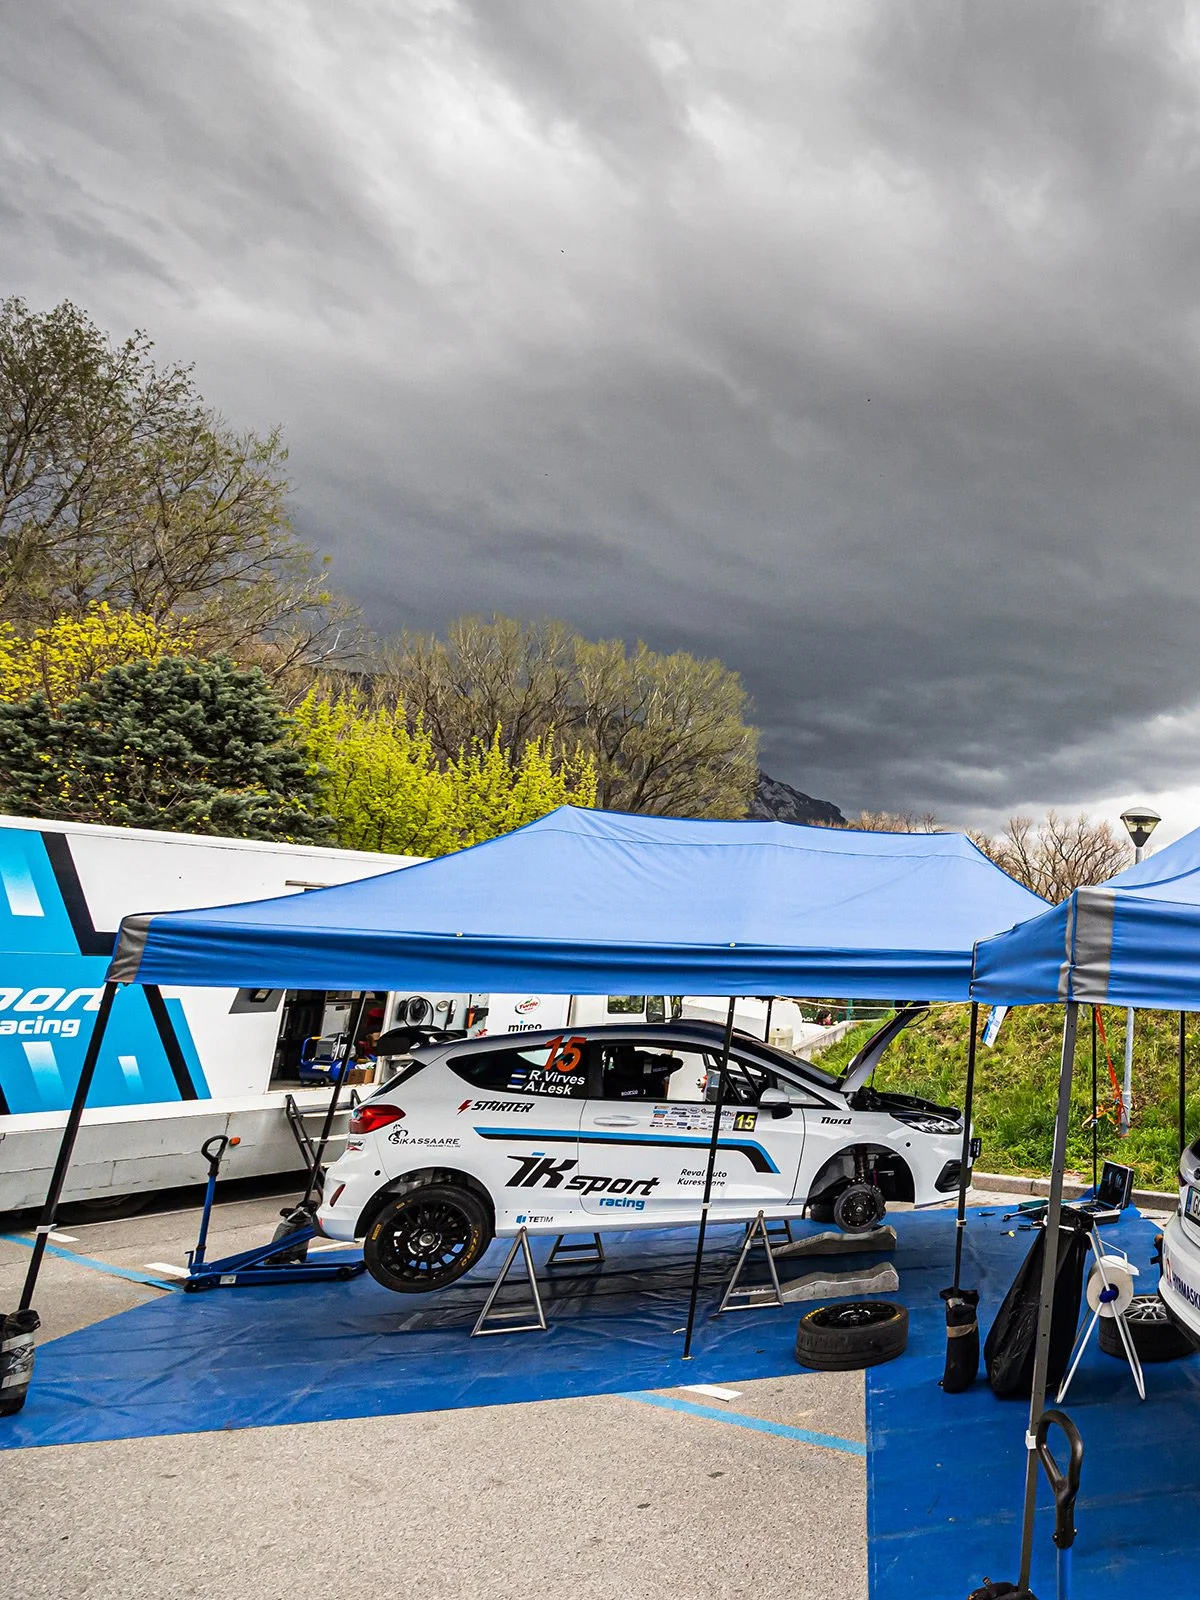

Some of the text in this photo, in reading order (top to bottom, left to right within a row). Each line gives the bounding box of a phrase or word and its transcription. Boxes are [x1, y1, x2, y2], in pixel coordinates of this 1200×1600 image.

[544, 1035, 587, 1072] 15
[529, 1070, 586, 1085] R.Virves
[524, 1081, 572, 1095] A.Lesk
[471, 1100, 535, 1113] STARTER
[736, 1114, 756, 1130] 15
[821, 1116, 852, 1125] Nord
[564, 1174, 660, 1196] sport
[599, 1197, 646, 1210] racing
[528, 1215, 554, 1223] TETIM
